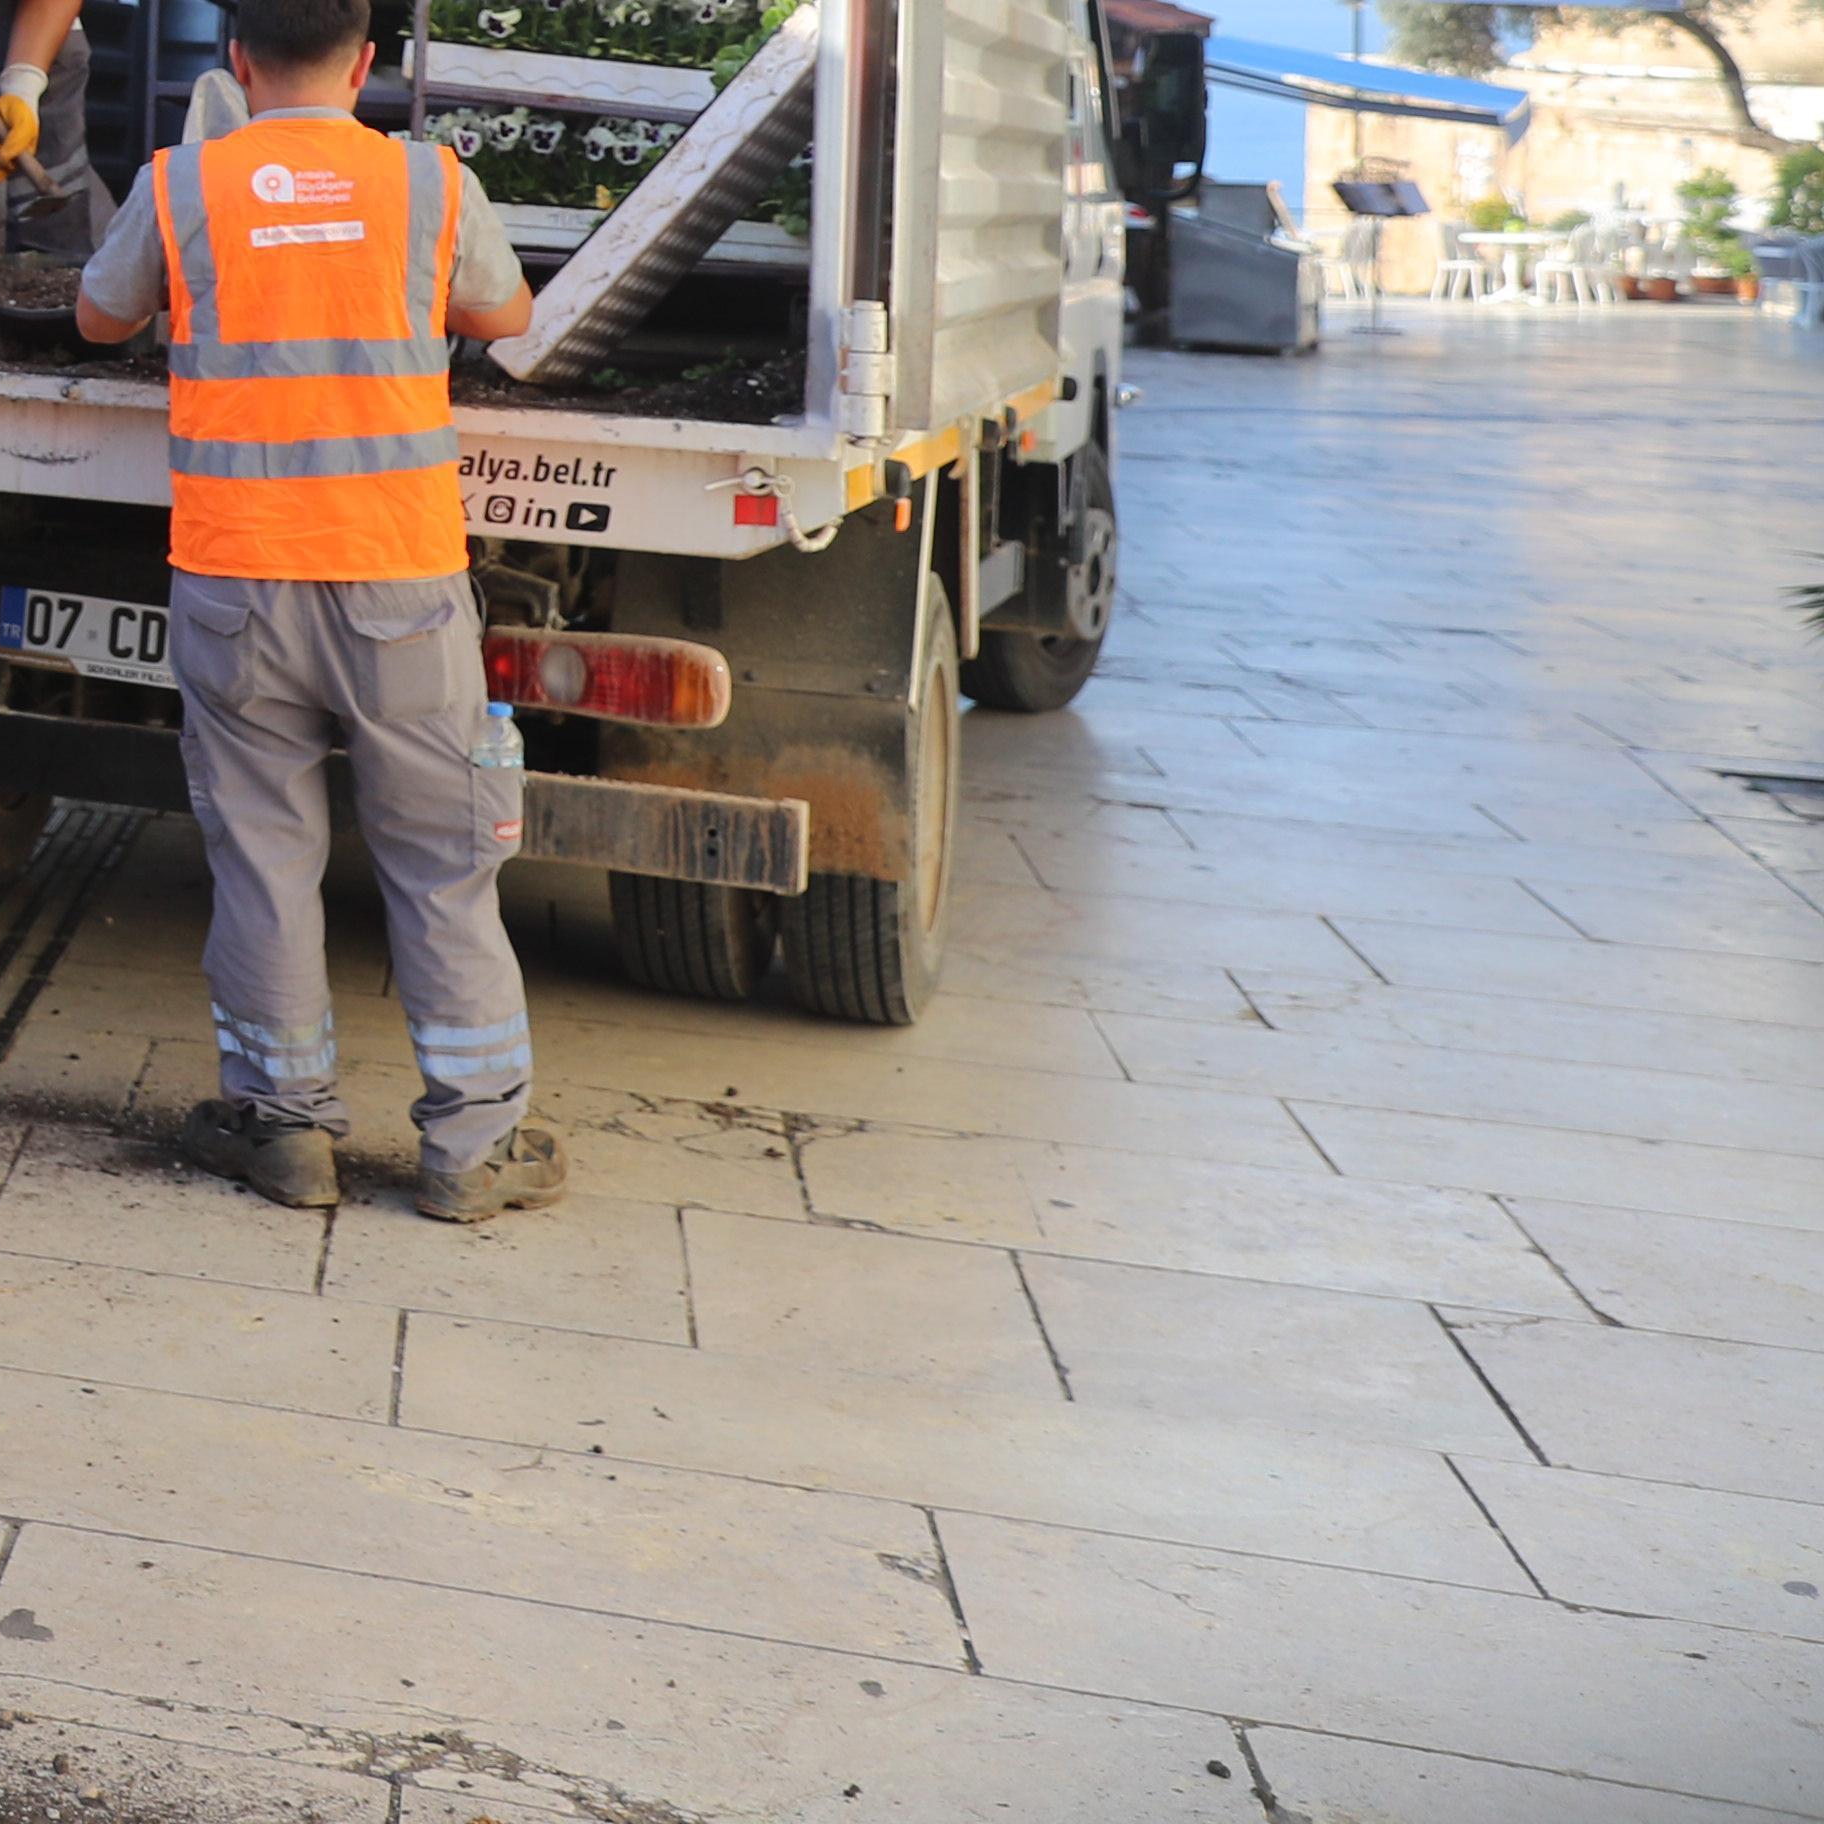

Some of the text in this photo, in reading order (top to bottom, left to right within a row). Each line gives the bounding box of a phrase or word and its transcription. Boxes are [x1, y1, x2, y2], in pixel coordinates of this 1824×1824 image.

[2, 622, 22, 640] TR
[26, 595, 168, 664] 07 CD
